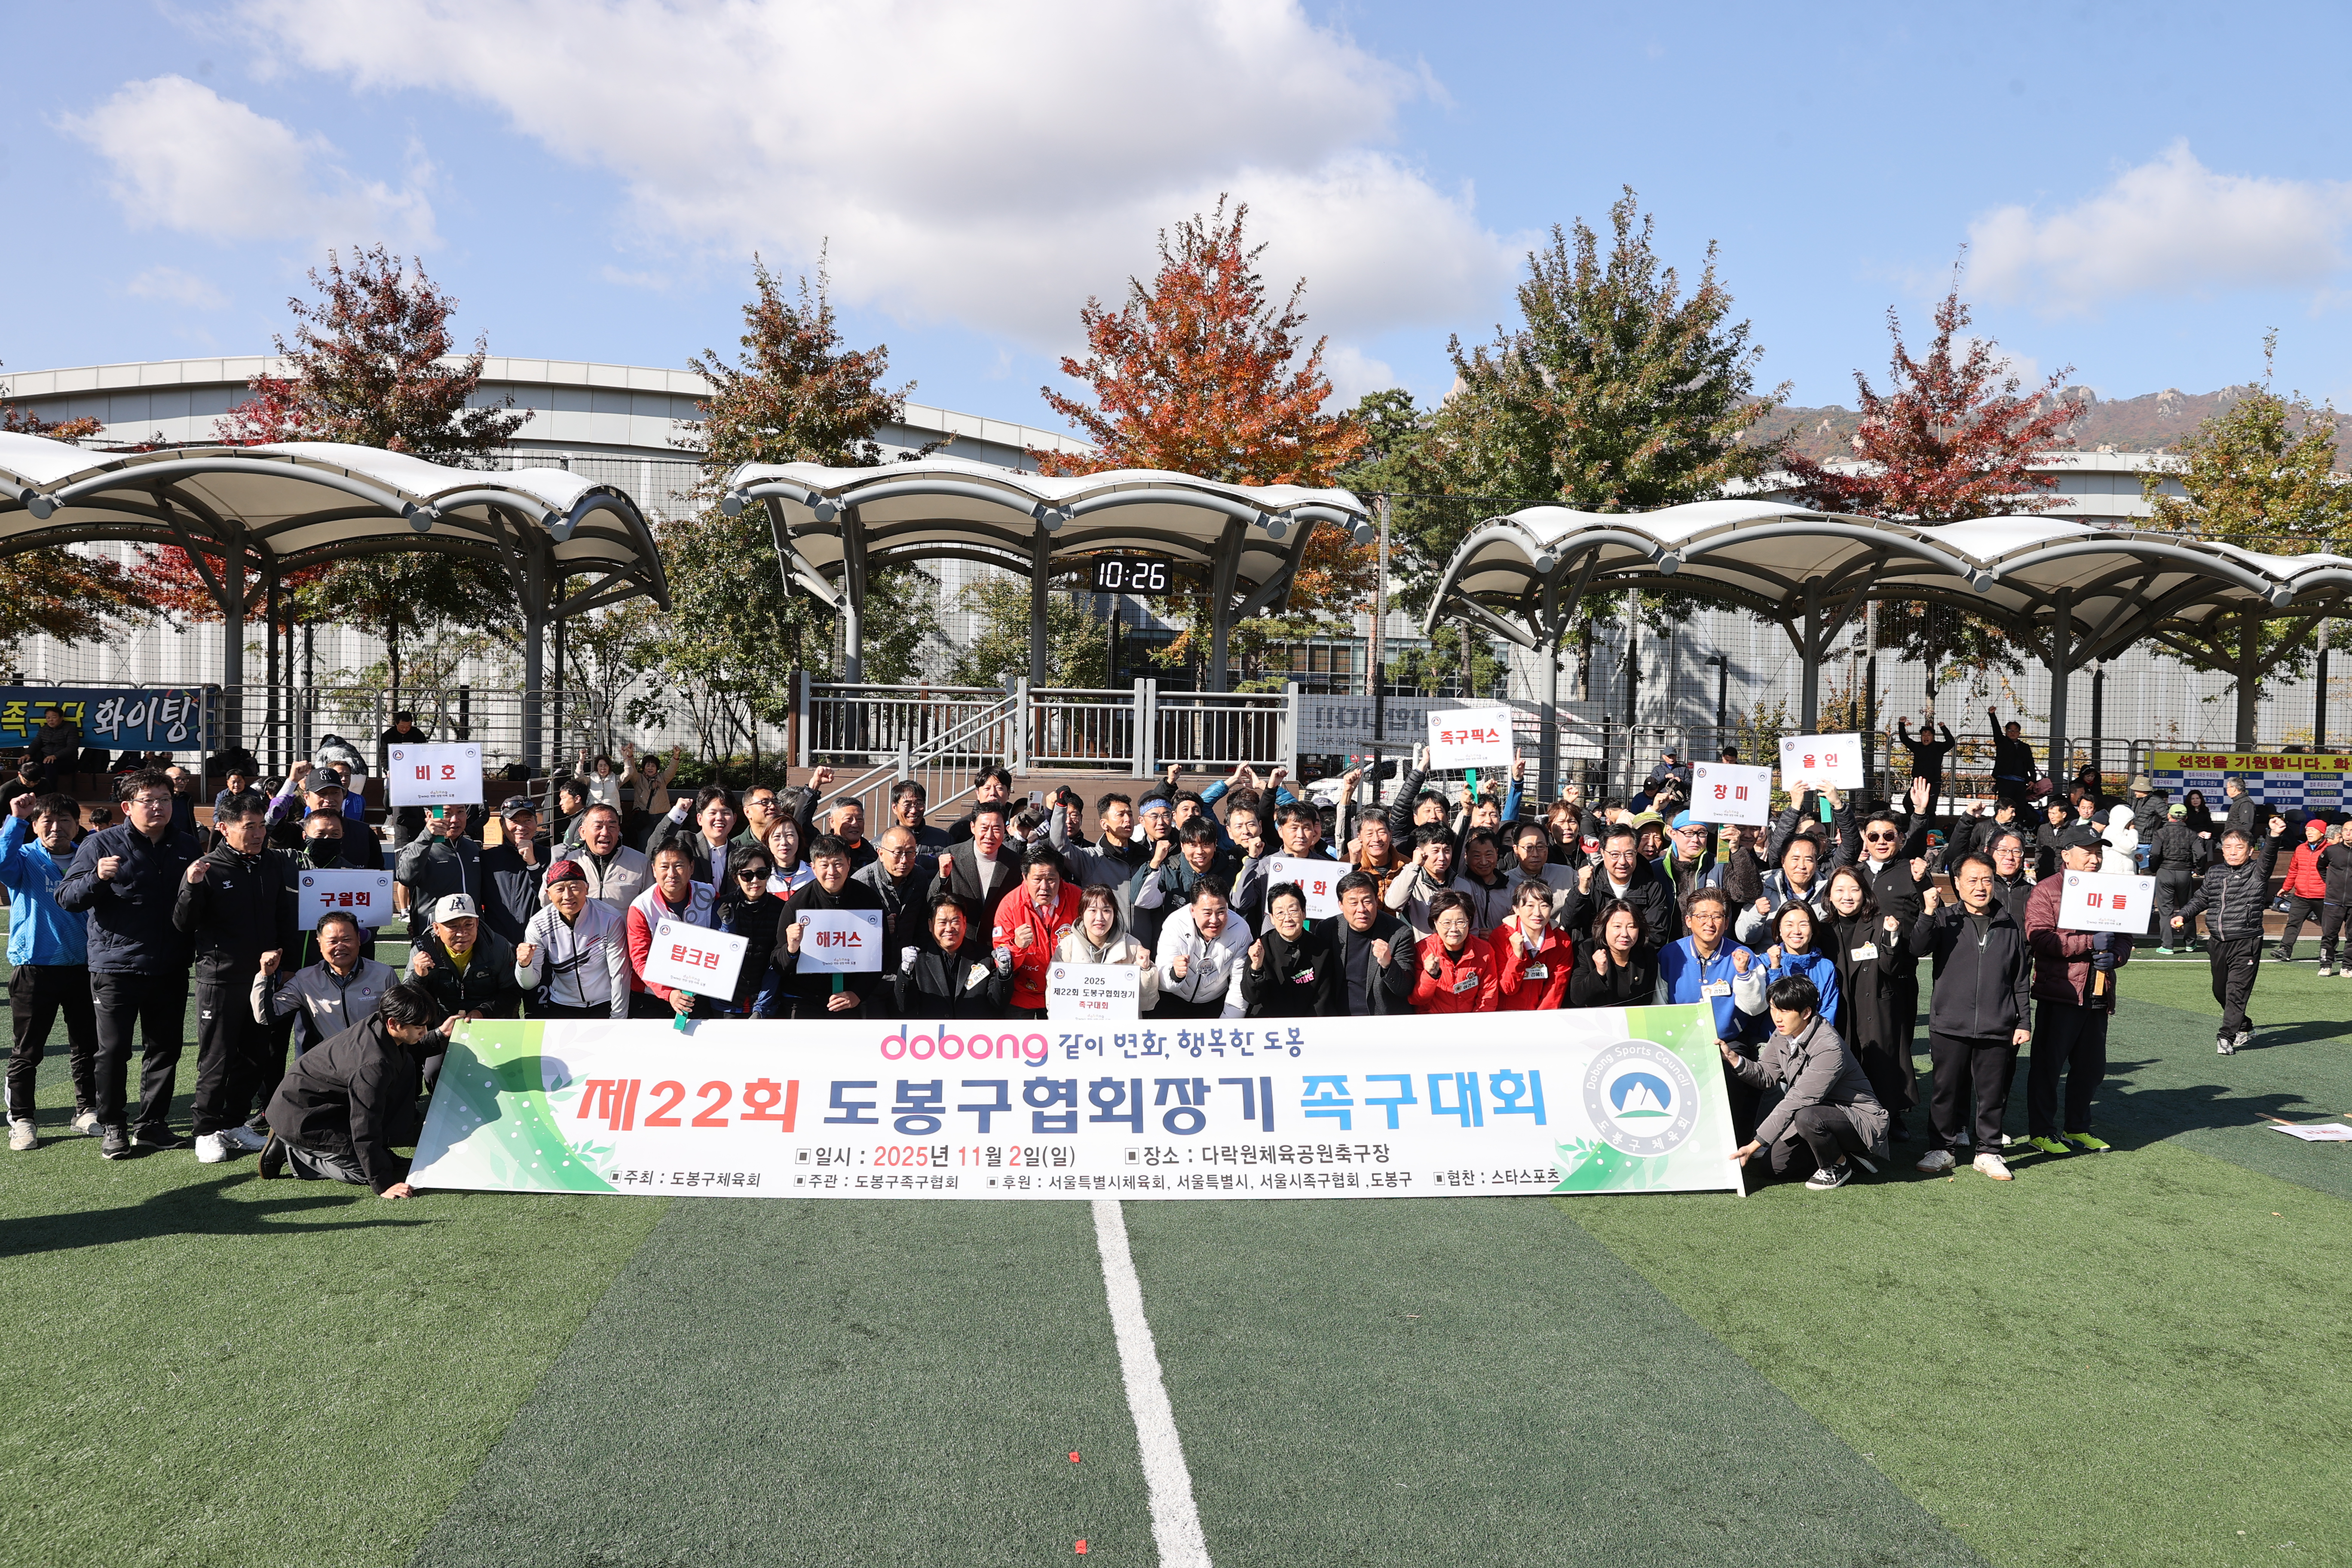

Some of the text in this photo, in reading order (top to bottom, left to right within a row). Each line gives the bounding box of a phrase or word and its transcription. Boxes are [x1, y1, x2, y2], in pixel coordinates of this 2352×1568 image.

[1099, 561, 1165, 589] 10:26
[1440, 728, 1500, 745] 족구픽스
[2177, 755, 2228, 769] 선전을
[2235, 756, 2327, 770] 기원합니다.
[319, 769, 331, 781] NY
[319, 891, 370, 907] 구월회
[816, 931, 862, 948] 해커스
[671, 944, 720, 970] 탑크린
[1053, 988, 1135, 998] 제22회 도봉구협회장기
[1079, 1001, 1109, 1009] 족구대회
[880, 1024, 1049, 1067] dobong
[1058, 1027, 1305, 1060] 같이 변화, 행복한 도봉
[1586, 1046, 1690, 1090] Dobong Sports Council
[576, 1069, 1547, 1136] 제22회 도봉구협회장기 족구대회
[815, 1146, 851, 1167] 일시
[873, 1145, 949, 1167] 2025년
[958, 1145, 1002, 1167] 11월
[1008, 1145, 1076, 1168] 2일(일)
[1143, 1146, 1180, 1166] 장소
[1202, 1143, 1390, 1165] 다락원체육공원축구장
[623, 1170, 655, 1186] 주최
[670, 1171, 761, 1188] 도봉구체육회
[808, 1174, 838, 1189] 주관
[854, 1174, 959, 1190] 도봉구족구협회
[1002, 1175, 1031, 1190] 후원
[1048, 1174, 1171, 1191] 서울특별시체육회,
[1177, 1173, 1254, 1191] 서울특별시,
[1447, 1169, 1475, 1186] 협찬
[1491, 1167, 1561, 1185] 스타스포츠
